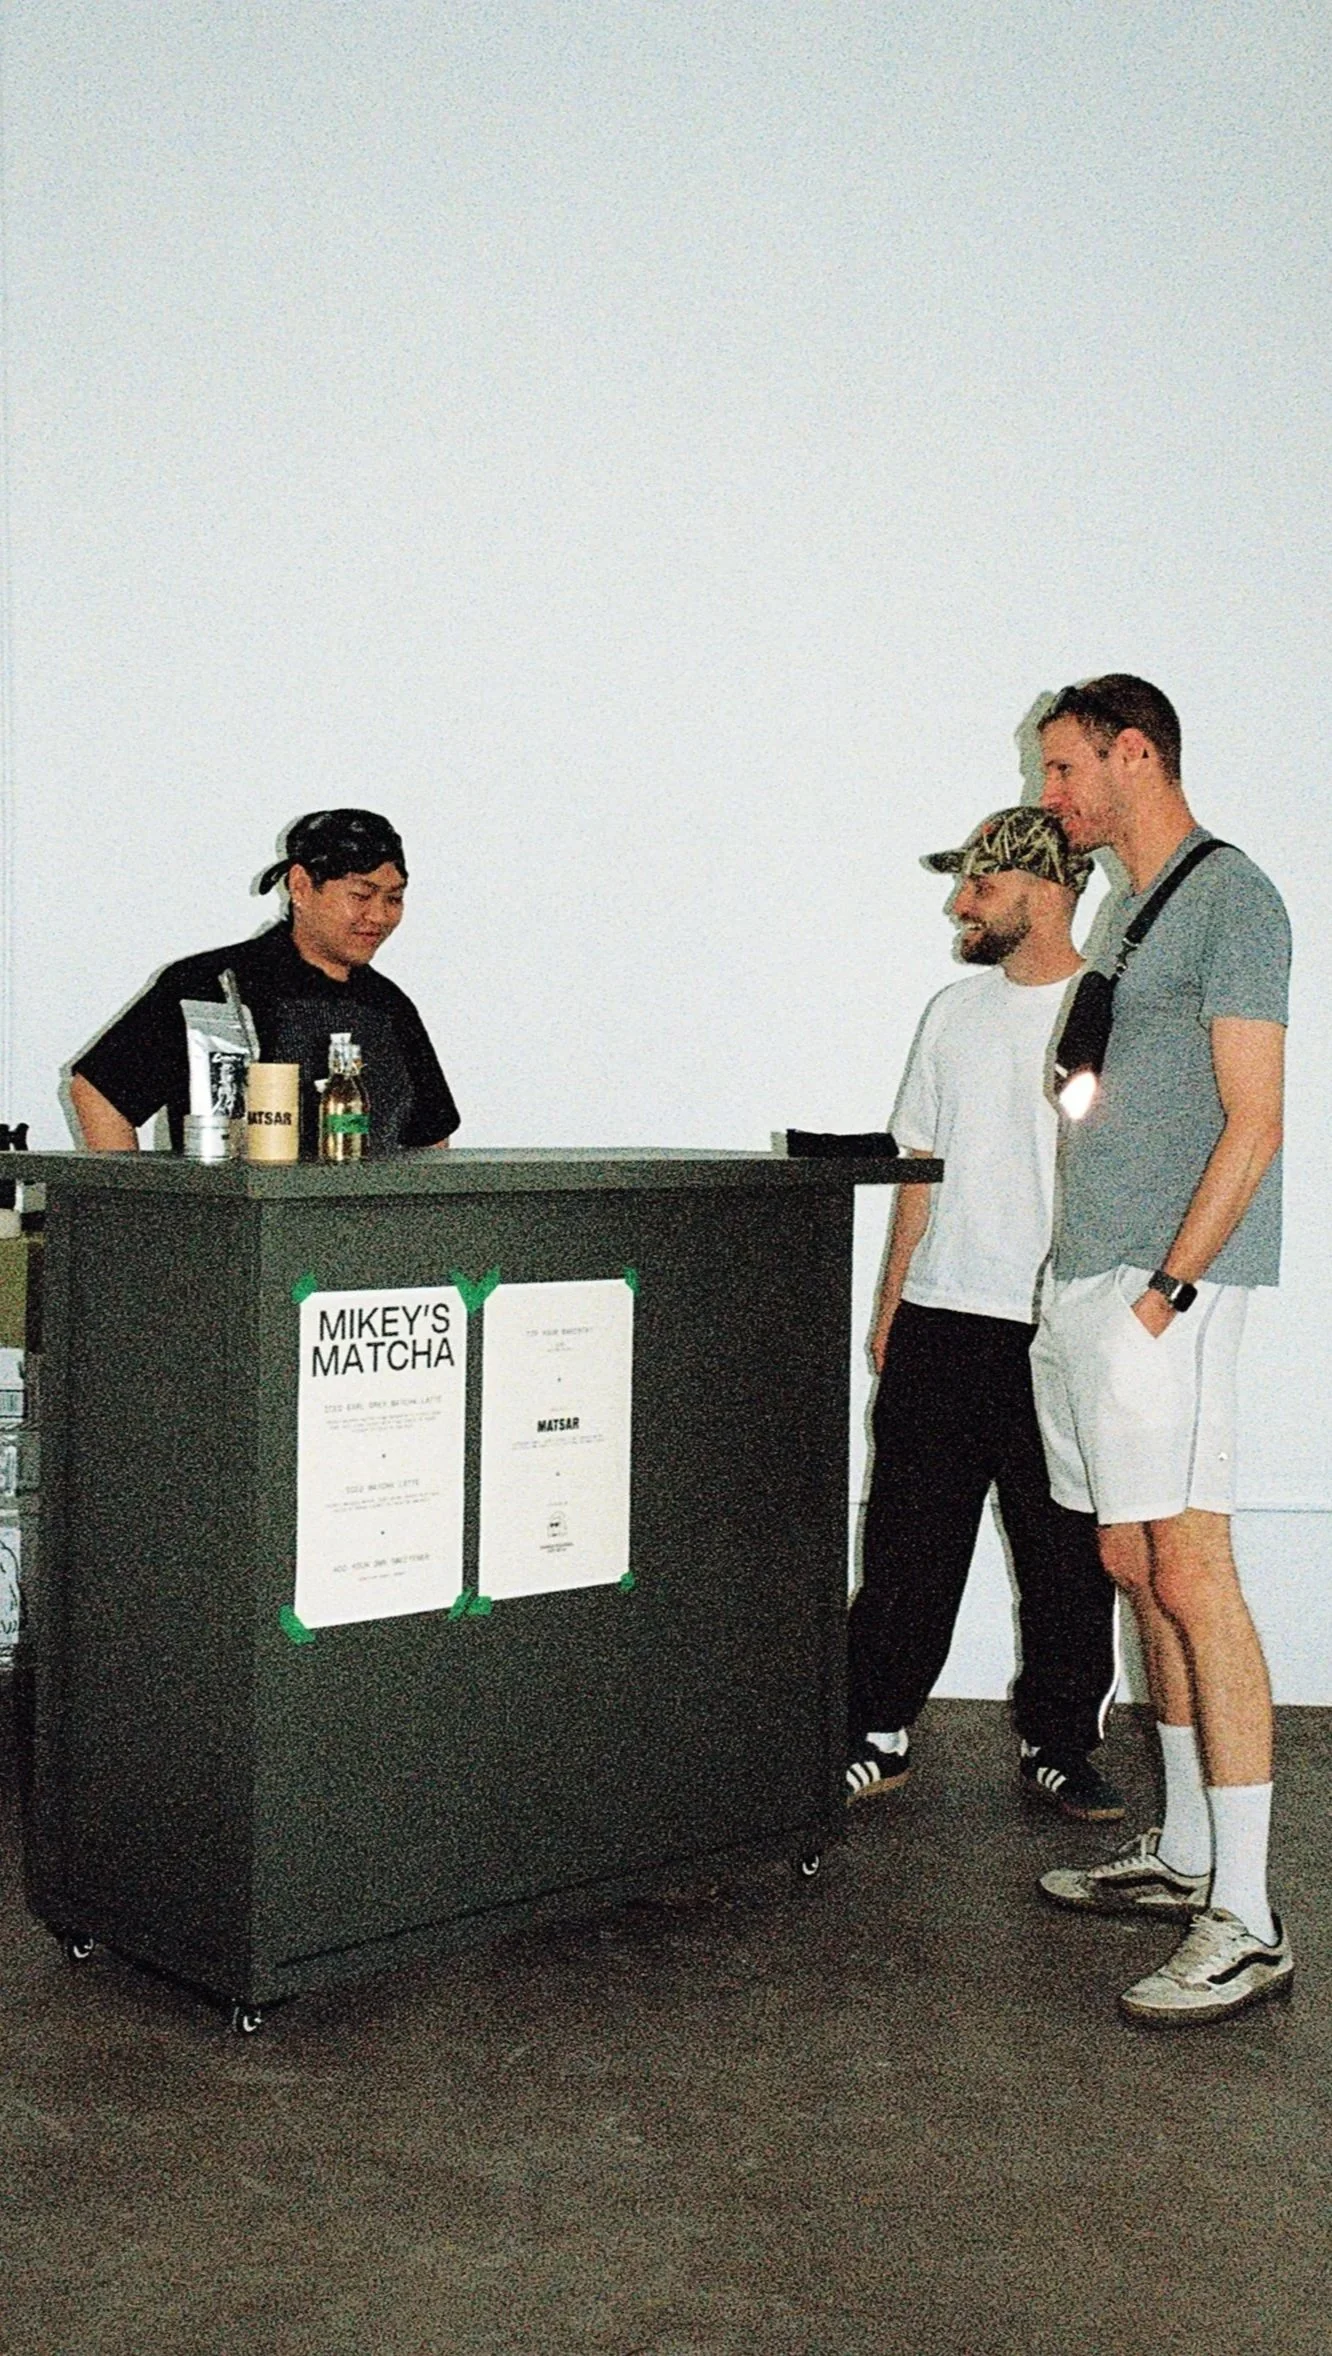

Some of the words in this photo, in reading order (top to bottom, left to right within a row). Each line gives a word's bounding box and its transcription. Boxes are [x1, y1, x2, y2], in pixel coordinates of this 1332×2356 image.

[320, 1303, 450, 1341] MIKEY'S
[312, 1337, 455, 1377] MATCHA
[537, 1417, 580, 1432] MATSAR
